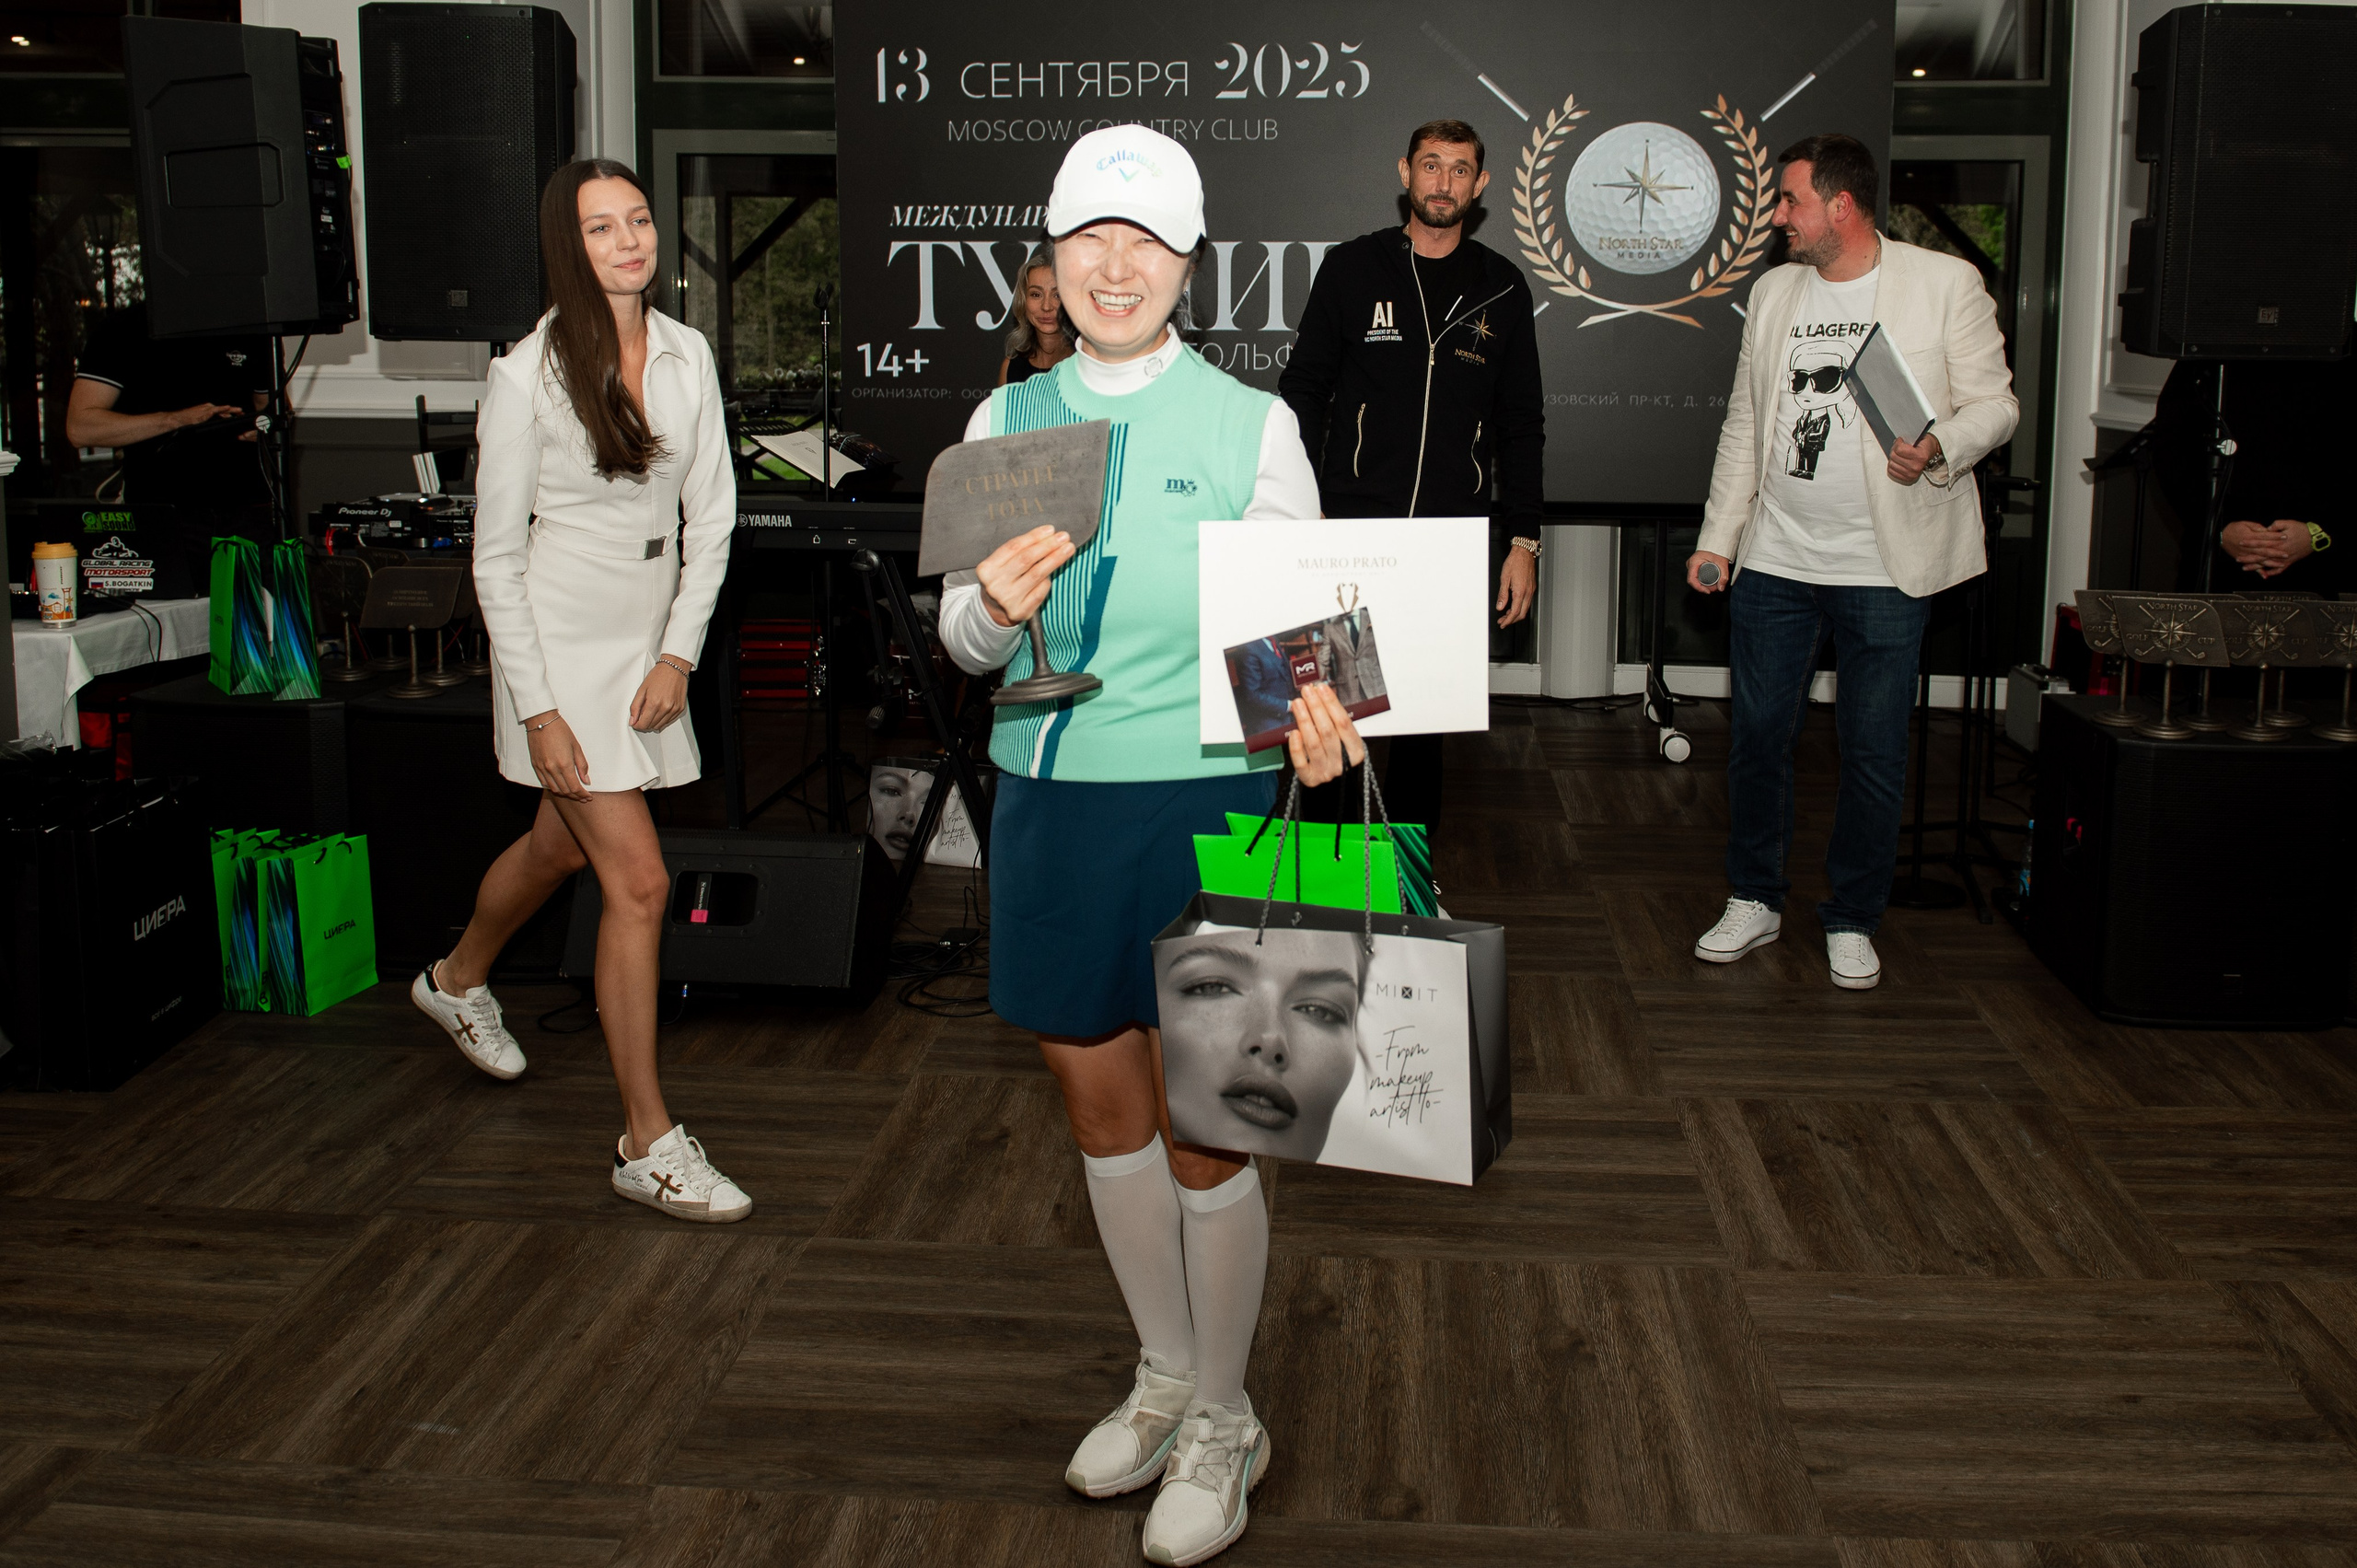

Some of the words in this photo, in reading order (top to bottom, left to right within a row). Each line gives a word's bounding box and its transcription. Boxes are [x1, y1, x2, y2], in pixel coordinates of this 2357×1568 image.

[877, 46, 930, 103] 13
[959, 61, 1189, 99] СЕНТЯБРЯ
[1214, 41, 1371, 99] 2025
[948, 119, 1072, 142] MOSCOW
[1211, 119, 1279, 141] CLUB
[889, 204, 1049, 231] МЕЖДУНАР
[1598, 237, 1647, 250] NORTH
[1650, 236, 1684, 250] STAR
[1372, 301, 1393, 329] AI
[1805, 322, 1872, 338] LAGERF
[856, 343, 930, 377] 14+
[851, 388, 952, 400] ОРГАНИЗАТОР:
[1629, 395, 1675, 408] ПР-КТ,
[1708, 395, 1725, 407] 26
[100, 511, 134, 522] EASY
[338, 507, 378, 516] Pioneer
[102, 521, 135, 531] SOUND
[748, 515, 793, 528] YAMAHA
[1296, 557, 1349, 570] MAURO
[1353, 556, 1398, 568] PRATO
[2178, 603, 2198, 612] STAR
[2242, 604, 2271, 612] NORTH
[2272, 605, 2292, 613] STAR
[1369, 1061, 1434, 1102] makeup
